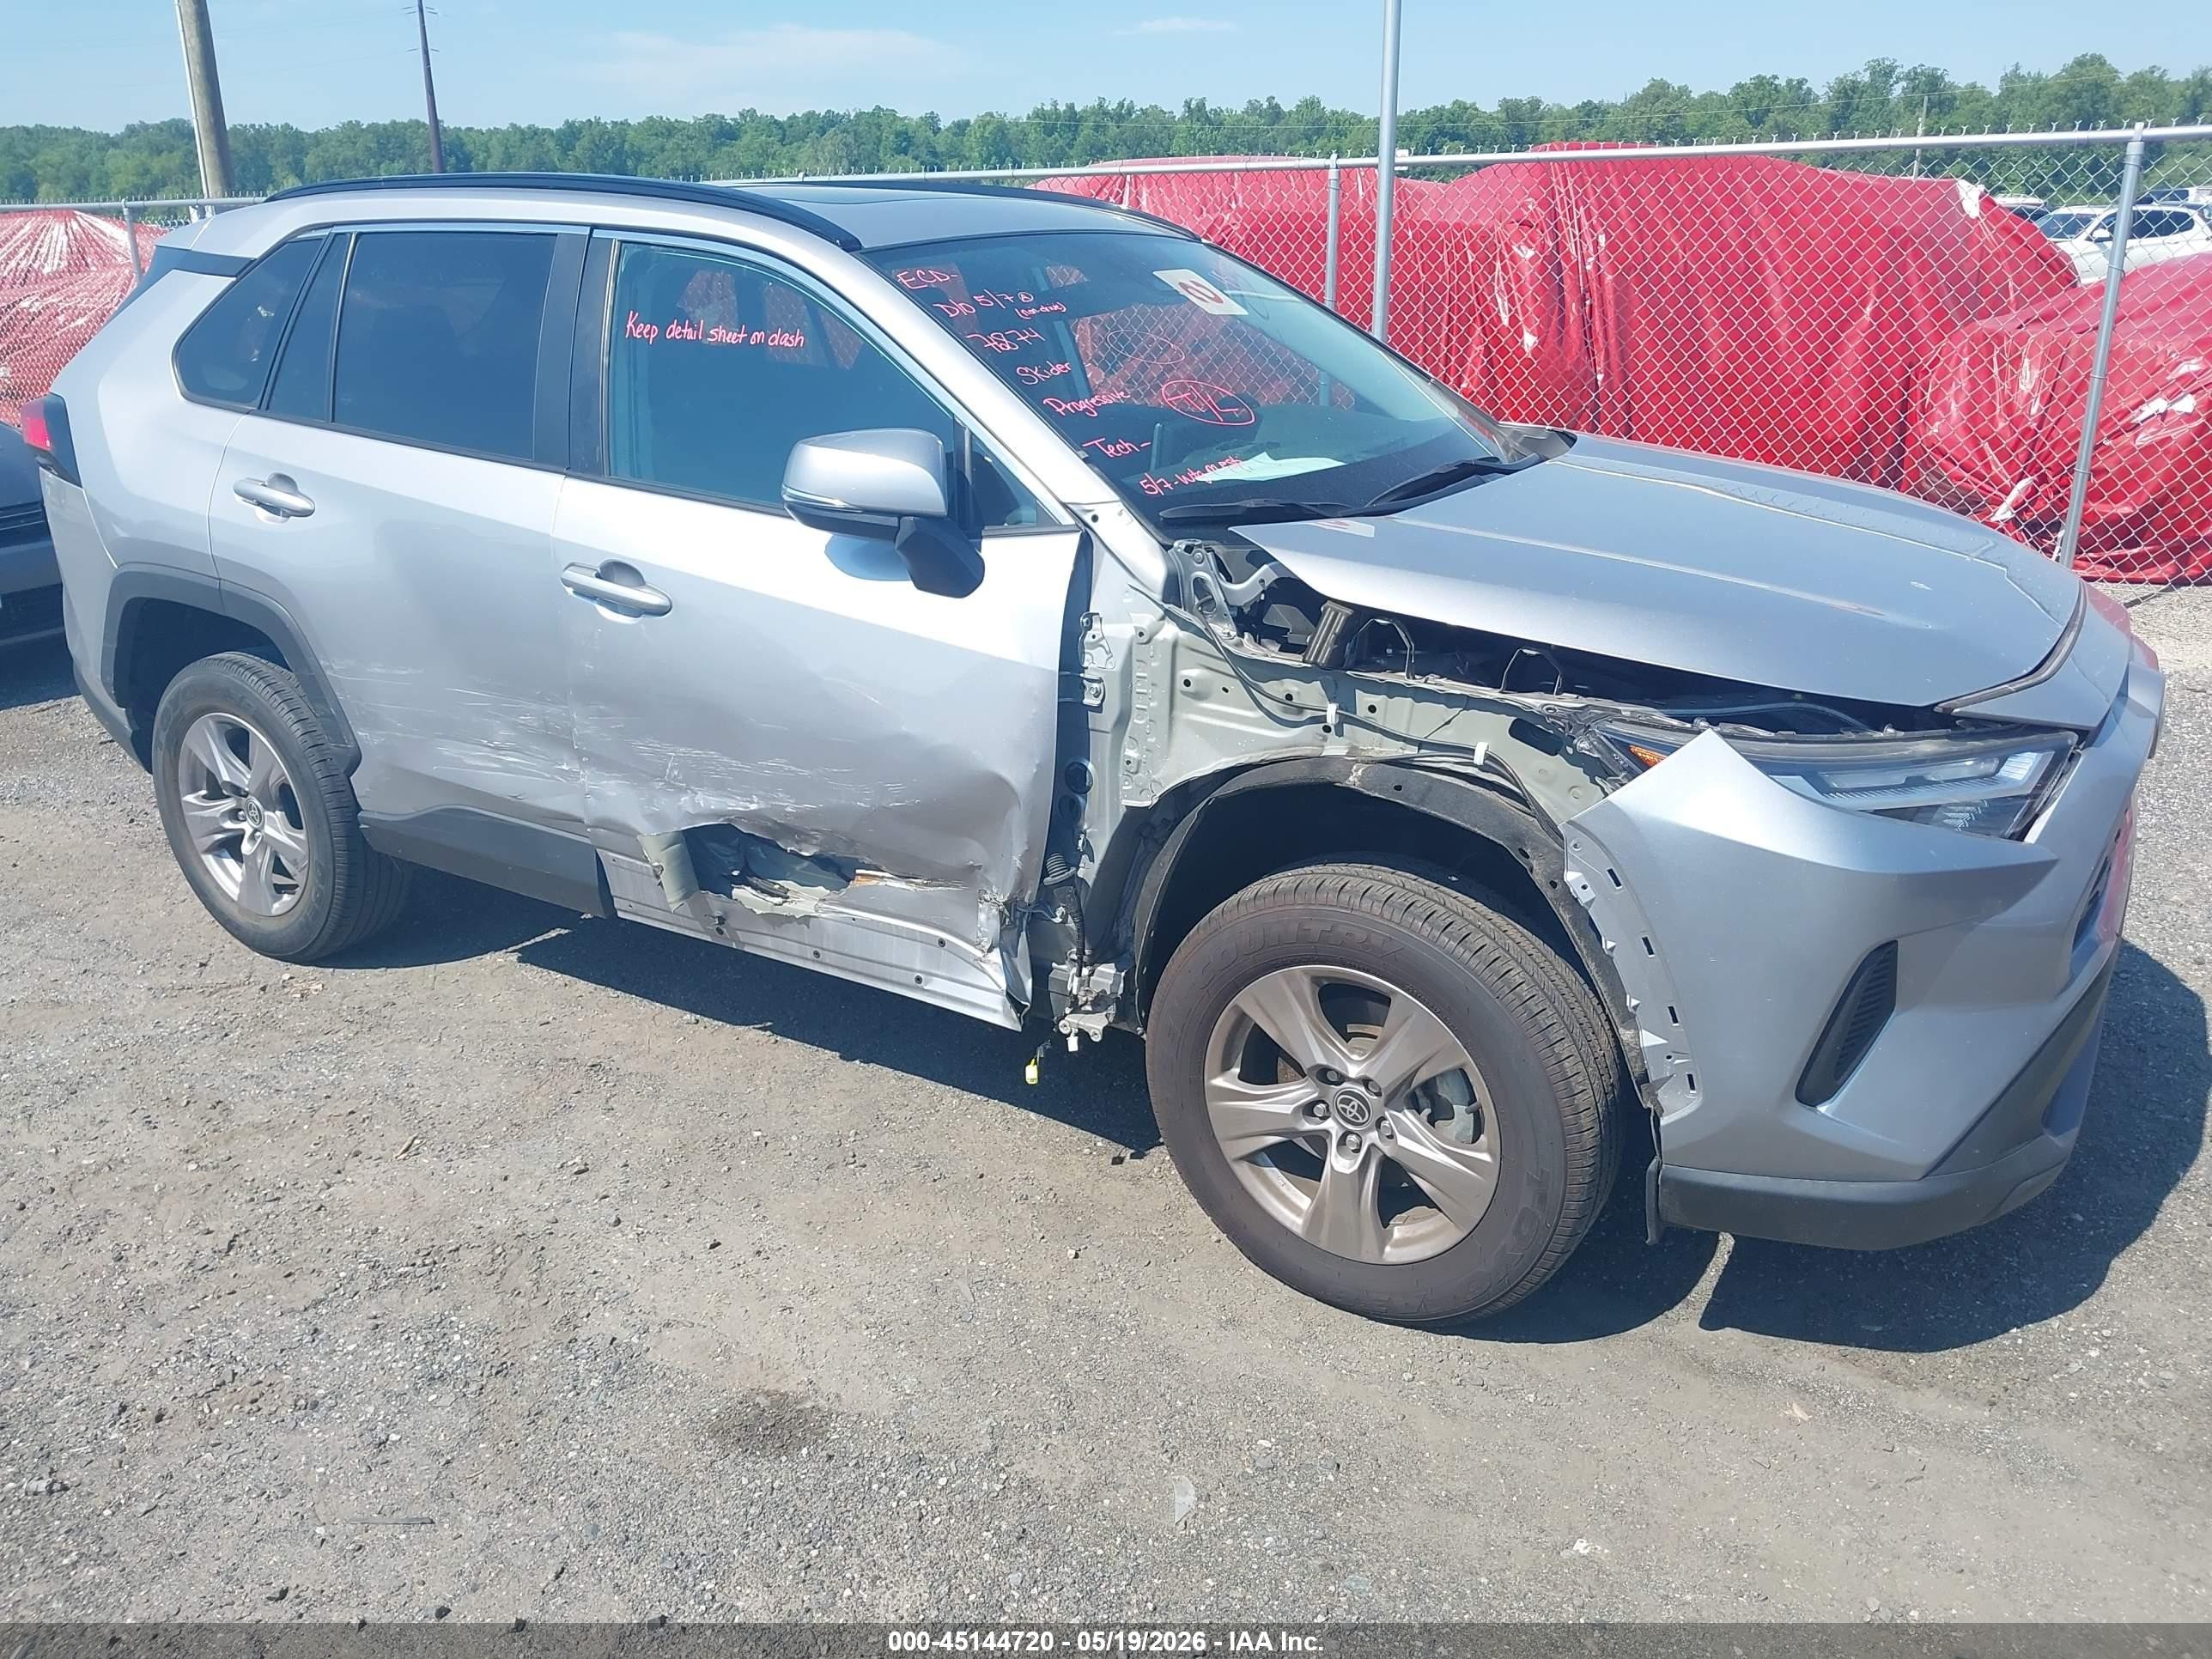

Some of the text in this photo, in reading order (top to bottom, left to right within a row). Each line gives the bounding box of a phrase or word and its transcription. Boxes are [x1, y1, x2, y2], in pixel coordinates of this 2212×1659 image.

[625, 310, 805, 348] Keep detail sheet on dash
[1043, 389, 1131, 417] Progressive
